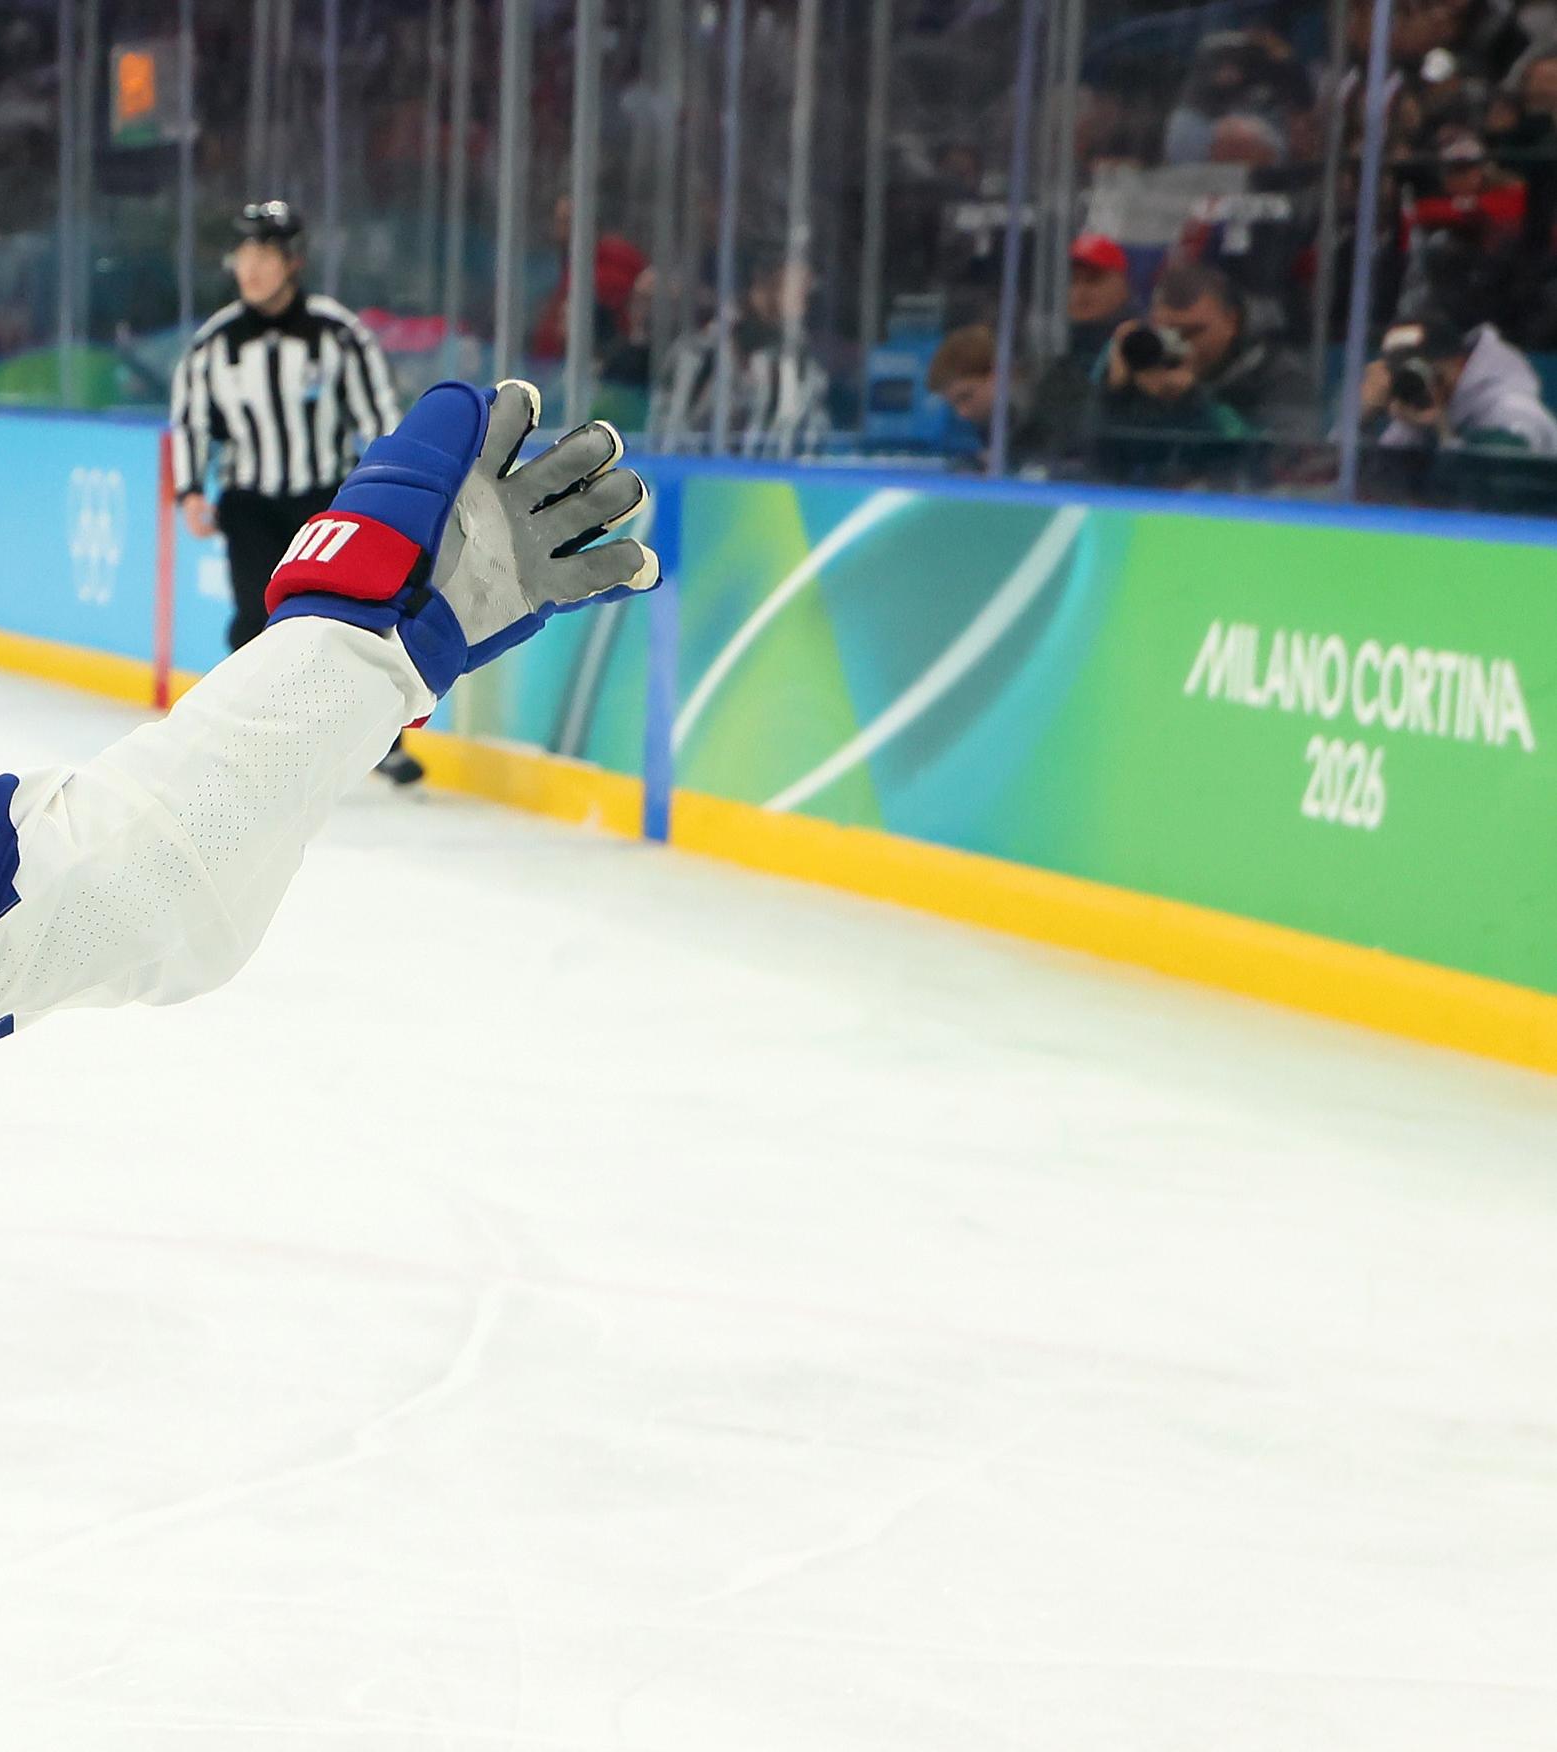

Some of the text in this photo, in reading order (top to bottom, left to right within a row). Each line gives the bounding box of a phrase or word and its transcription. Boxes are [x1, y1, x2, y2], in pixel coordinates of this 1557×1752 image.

[1183, 619, 1536, 753] MILANO CORTINA
[1300, 734, 1386, 832] 2026
